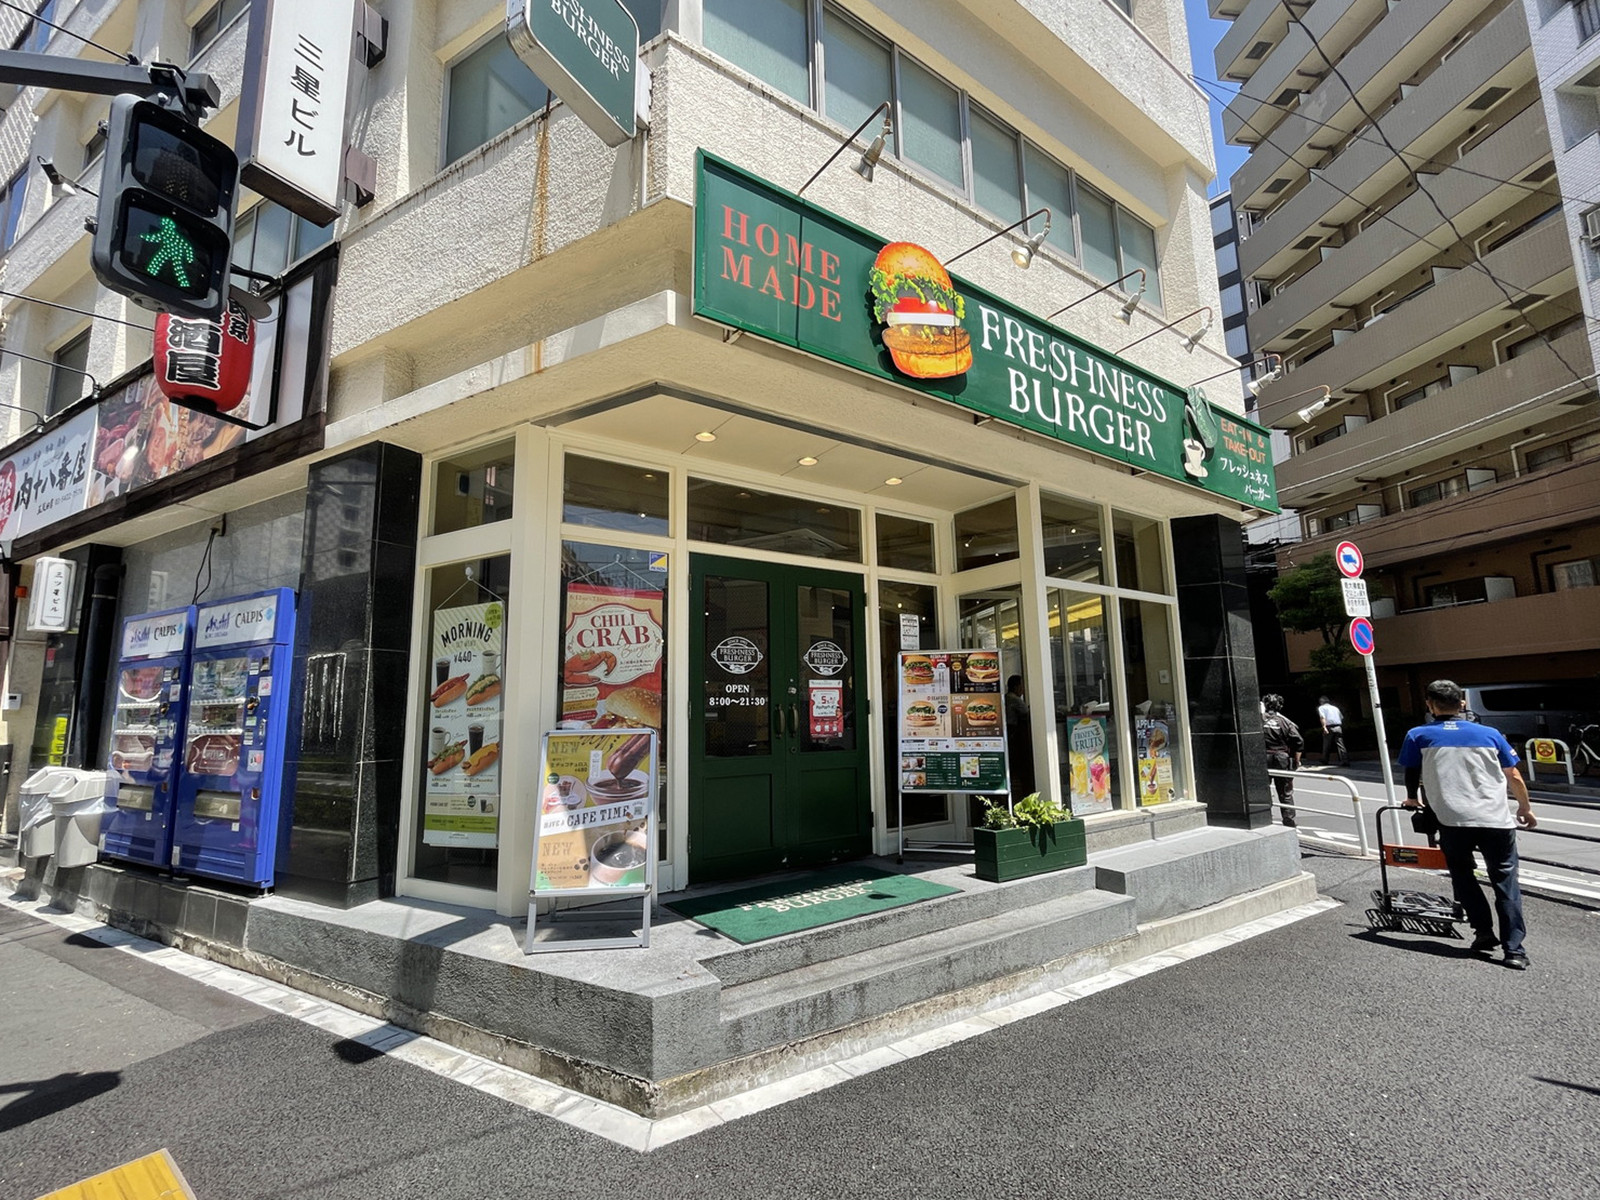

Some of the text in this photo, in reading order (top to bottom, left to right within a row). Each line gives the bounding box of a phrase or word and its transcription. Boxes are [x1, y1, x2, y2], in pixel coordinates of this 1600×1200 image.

[551, 0, 620, 81] BURGER
[564, 0, 630, 73] SHNESS
[283, 33, 325, 157] 三星ビル
[720, 203, 841, 286] HOME
[720, 245, 842, 322] MADE
[166, 310, 224, 390] 酒屋
[978, 304, 1167, 424] FRESHNESS
[1007, 366, 1157, 462] BURGER
[1220, 417, 1265, 449] EAT-IN &
[1222, 435, 1267, 465] TAKE-OUT
[1220, 457, 1270, 487] フレッシュネス
[1244, 484, 1271, 501] バーガー
[235, 608, 264, 629] CALPIS
[590, 613, 635, 628] CHILI
[153, 624, 177, 641] CALPIS
[441, 620, 493, 648] MORNING
[576, 625, 650, 649] CRAB
[719, 648, 756, 656] FRESHNESS
[723, 654, 753, 662] BURGER
[810, 651, 841, 659] FRESHNESS
[725, 684, 750, 693] OPEN
[551, 741, 580, 754] NEW
[1075, 736, 1103, 751] FRUITS
[566, 811, 597, 827] CAFE
[600, 805, 629, 819] TIME
[542, 840, 573, 857] NEW
[768, 886, 873, 913] BURGER
